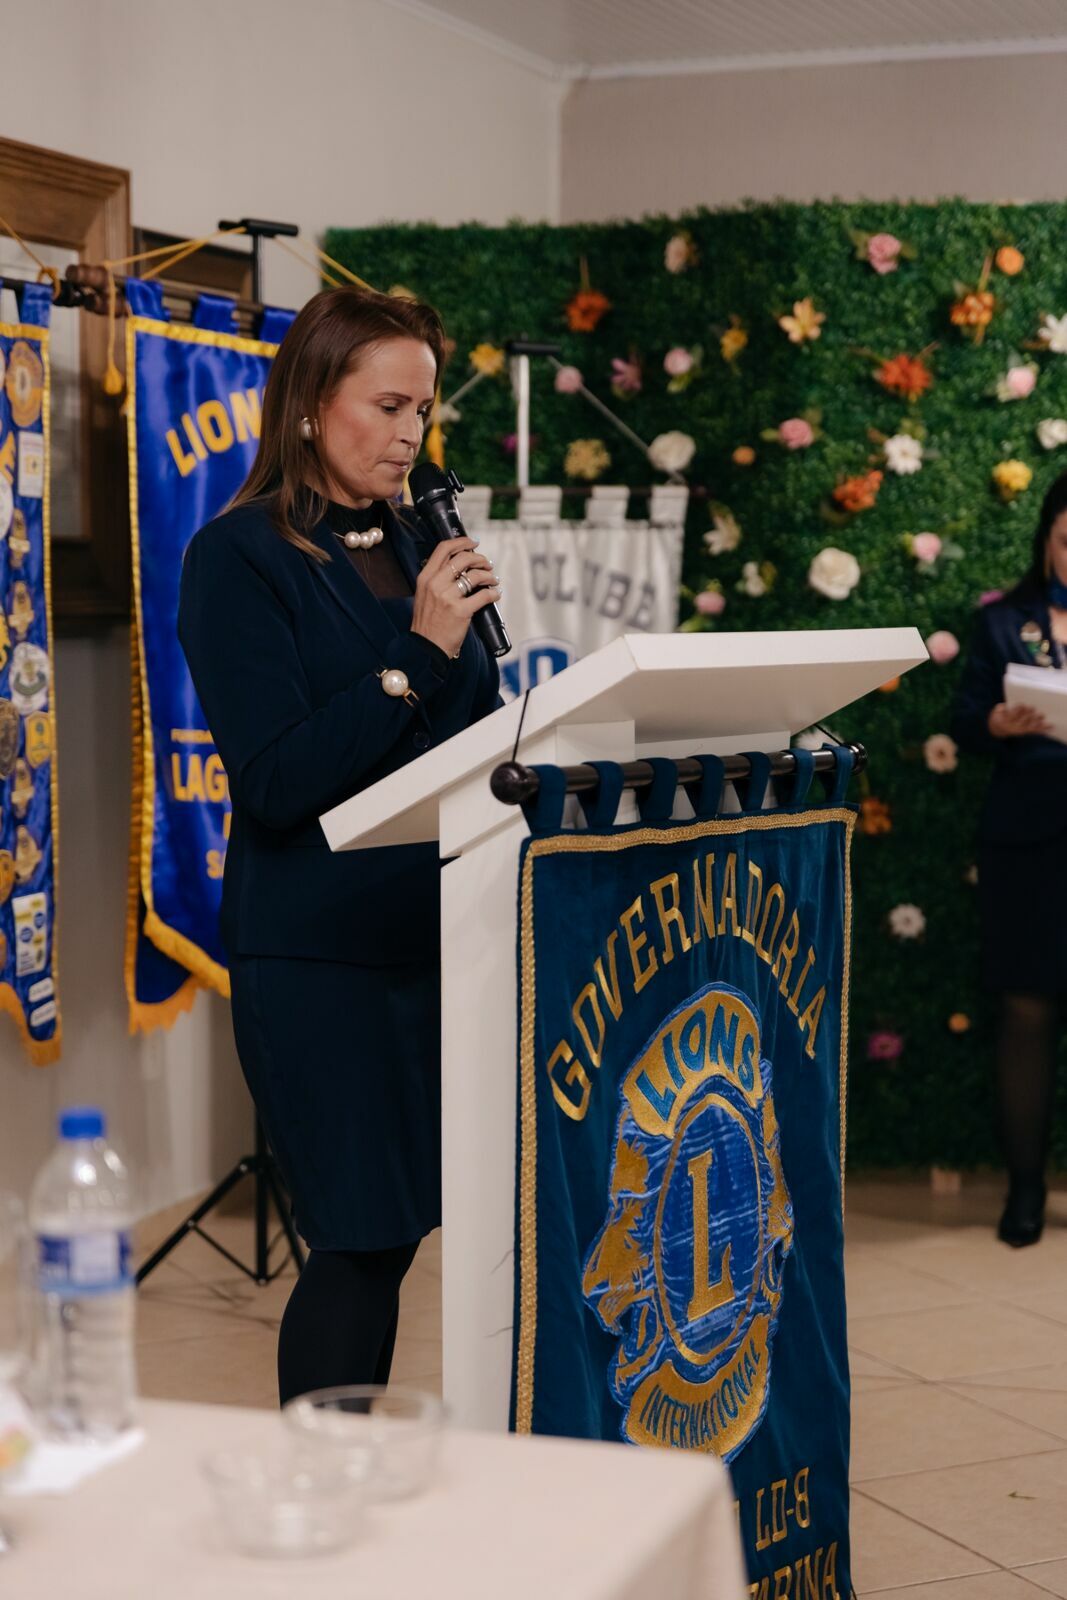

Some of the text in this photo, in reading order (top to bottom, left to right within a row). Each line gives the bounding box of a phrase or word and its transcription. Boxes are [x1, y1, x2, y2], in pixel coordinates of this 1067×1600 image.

[166, 387, 266, 478] LION
[171, 752, 231, 803] LAG
[547, 853, 826, 1121] GOVERNADORIA
[635, 1003, 756, 1122] LIONS
[687, 1148, 736, 1321] L
[639, 1339, 761, 1449] INTERNATIONAL
[755, 1466, 811, 1551] LD-8
[747, 1541, 840, 1600] RINA
